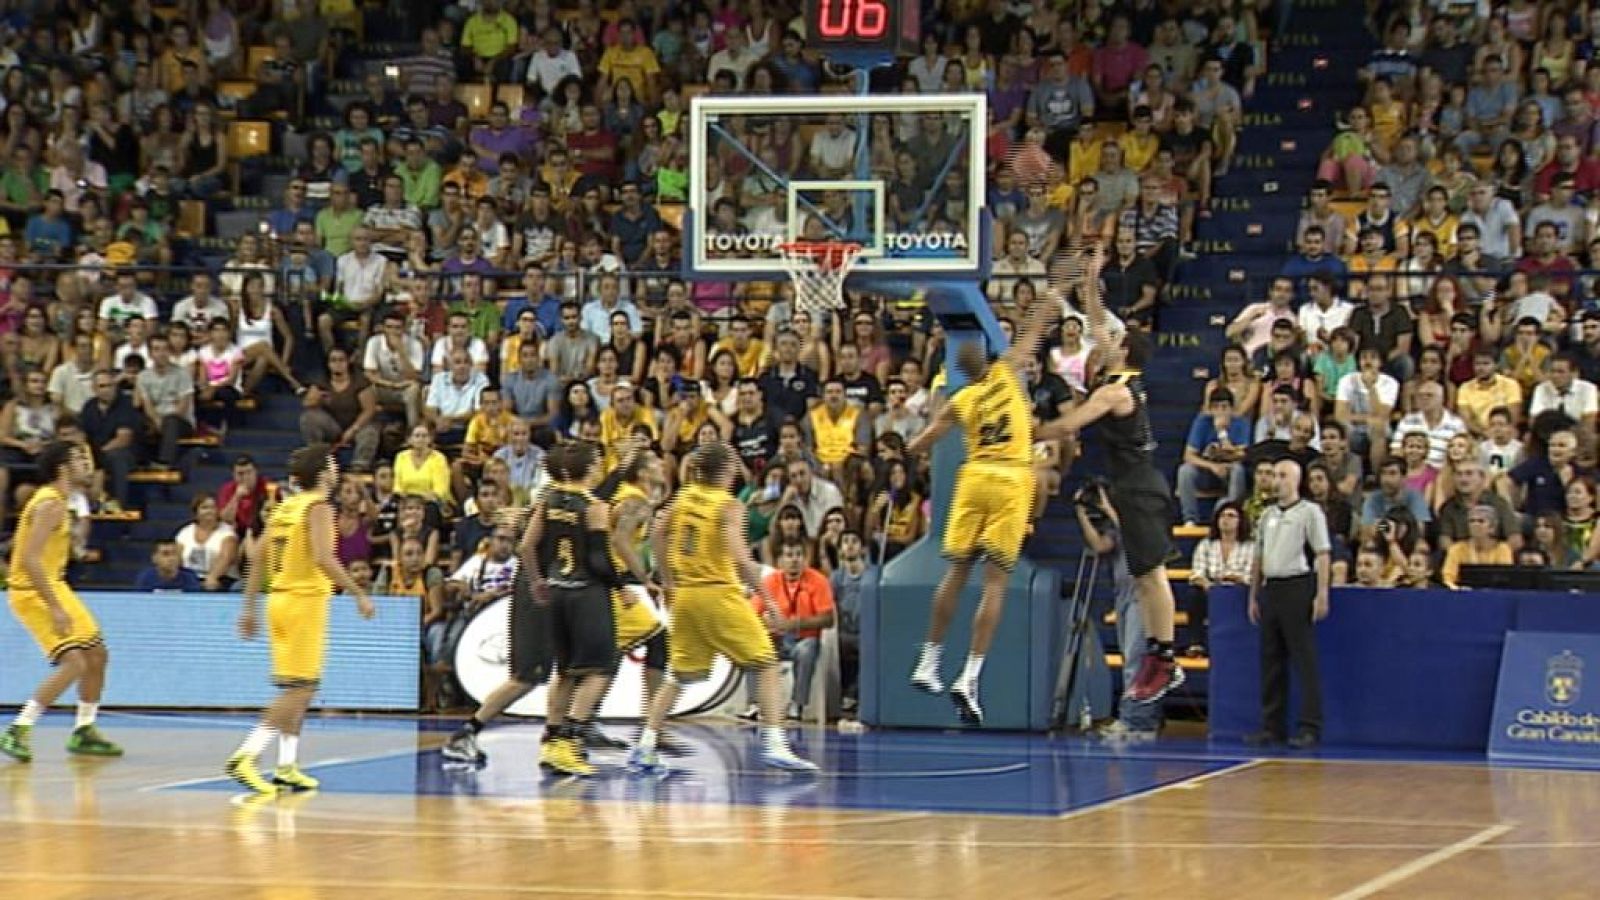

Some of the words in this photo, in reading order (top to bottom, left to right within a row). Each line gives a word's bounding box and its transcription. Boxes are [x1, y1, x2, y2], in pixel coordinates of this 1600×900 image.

[705, 233, 784, 250] TOYOTA
[886, 232, 966, 249] TOYOTA
[1518, 710, 1577, 725] Cabildo
[1507, 724, 1545, 739] Gran
